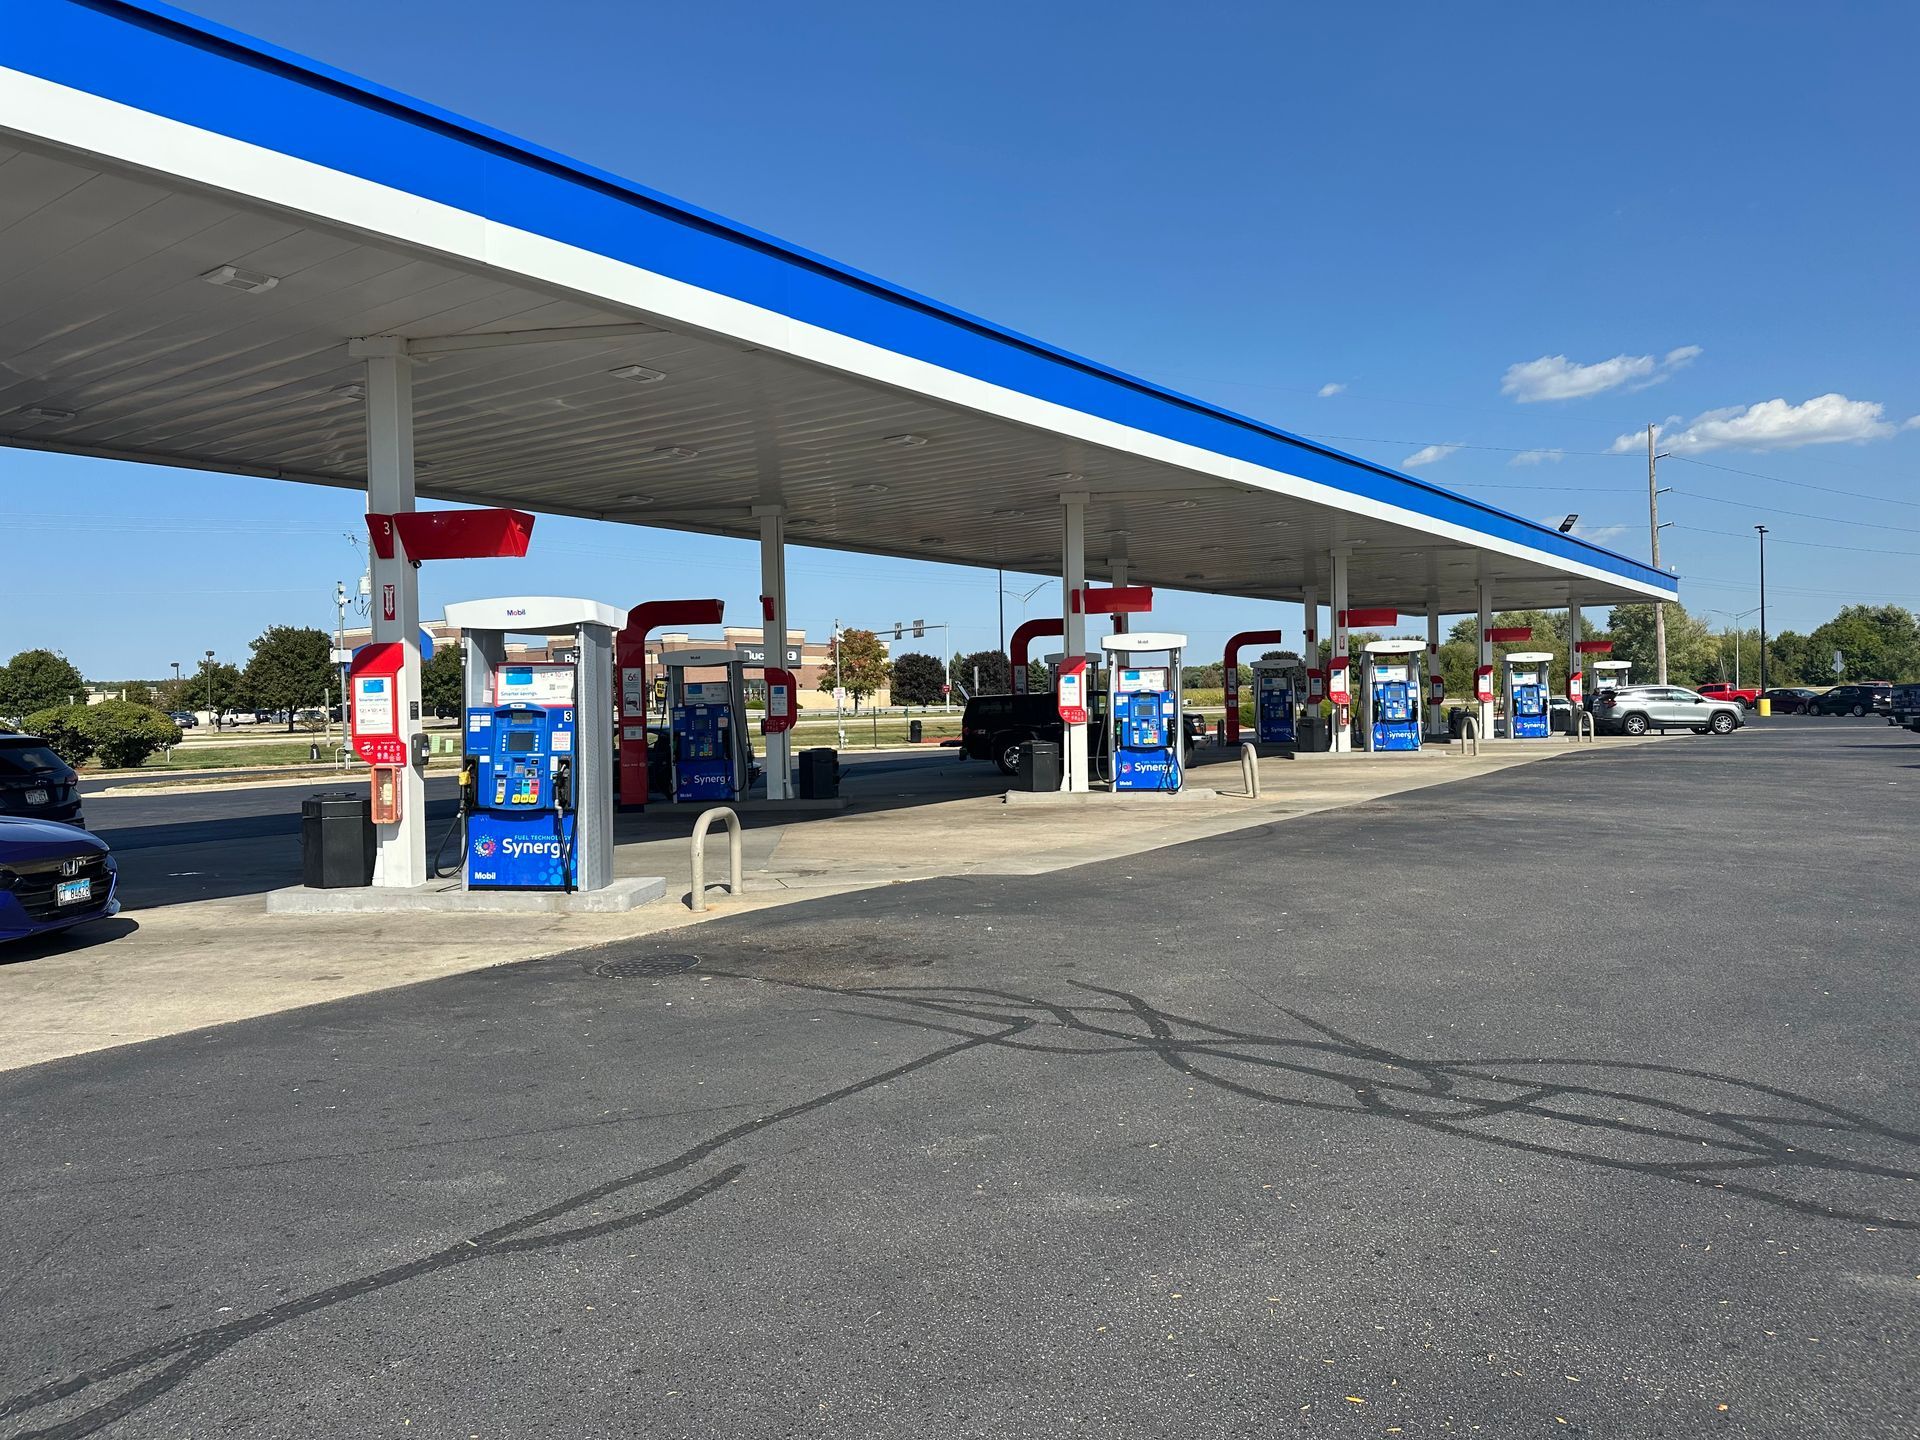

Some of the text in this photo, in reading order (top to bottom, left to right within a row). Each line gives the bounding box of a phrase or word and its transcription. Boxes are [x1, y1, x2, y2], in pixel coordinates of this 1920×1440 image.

[383, 521, 391, 535] 3
[506, 608, 526, 617] Mobil
[565, 711, 572, 721] 3
[1134, 762, 1175, 774] Synergy
[474, 871, 496, 880] Mobil
